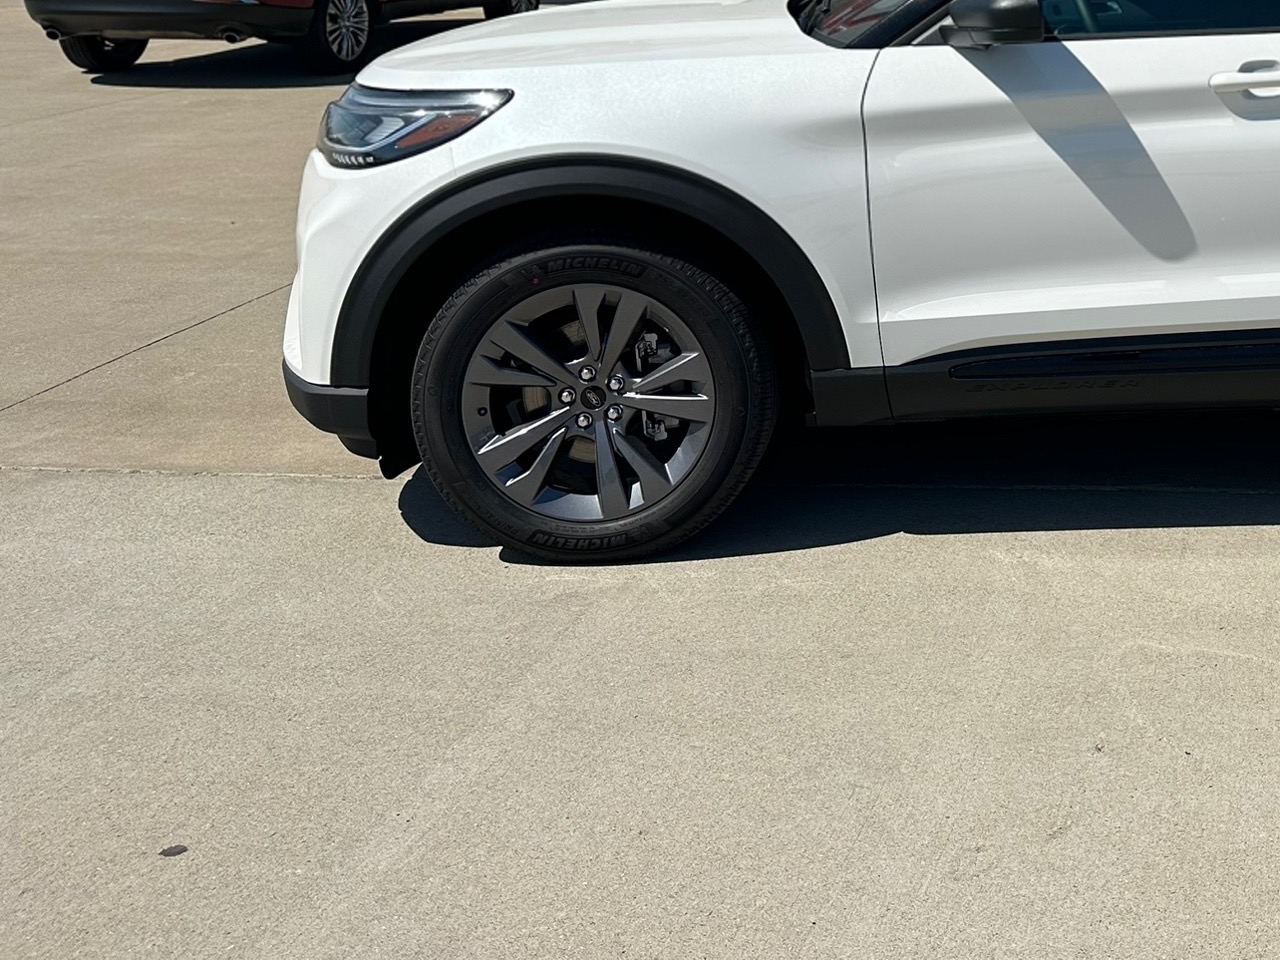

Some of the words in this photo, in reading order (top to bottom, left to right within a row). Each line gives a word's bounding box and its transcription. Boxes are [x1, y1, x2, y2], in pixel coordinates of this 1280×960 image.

[546, 256, 643, 276] MICHELIN
[967, 378, 1141, 392] EXPLORER
[534, 532, 628, 551] MICHELIN
